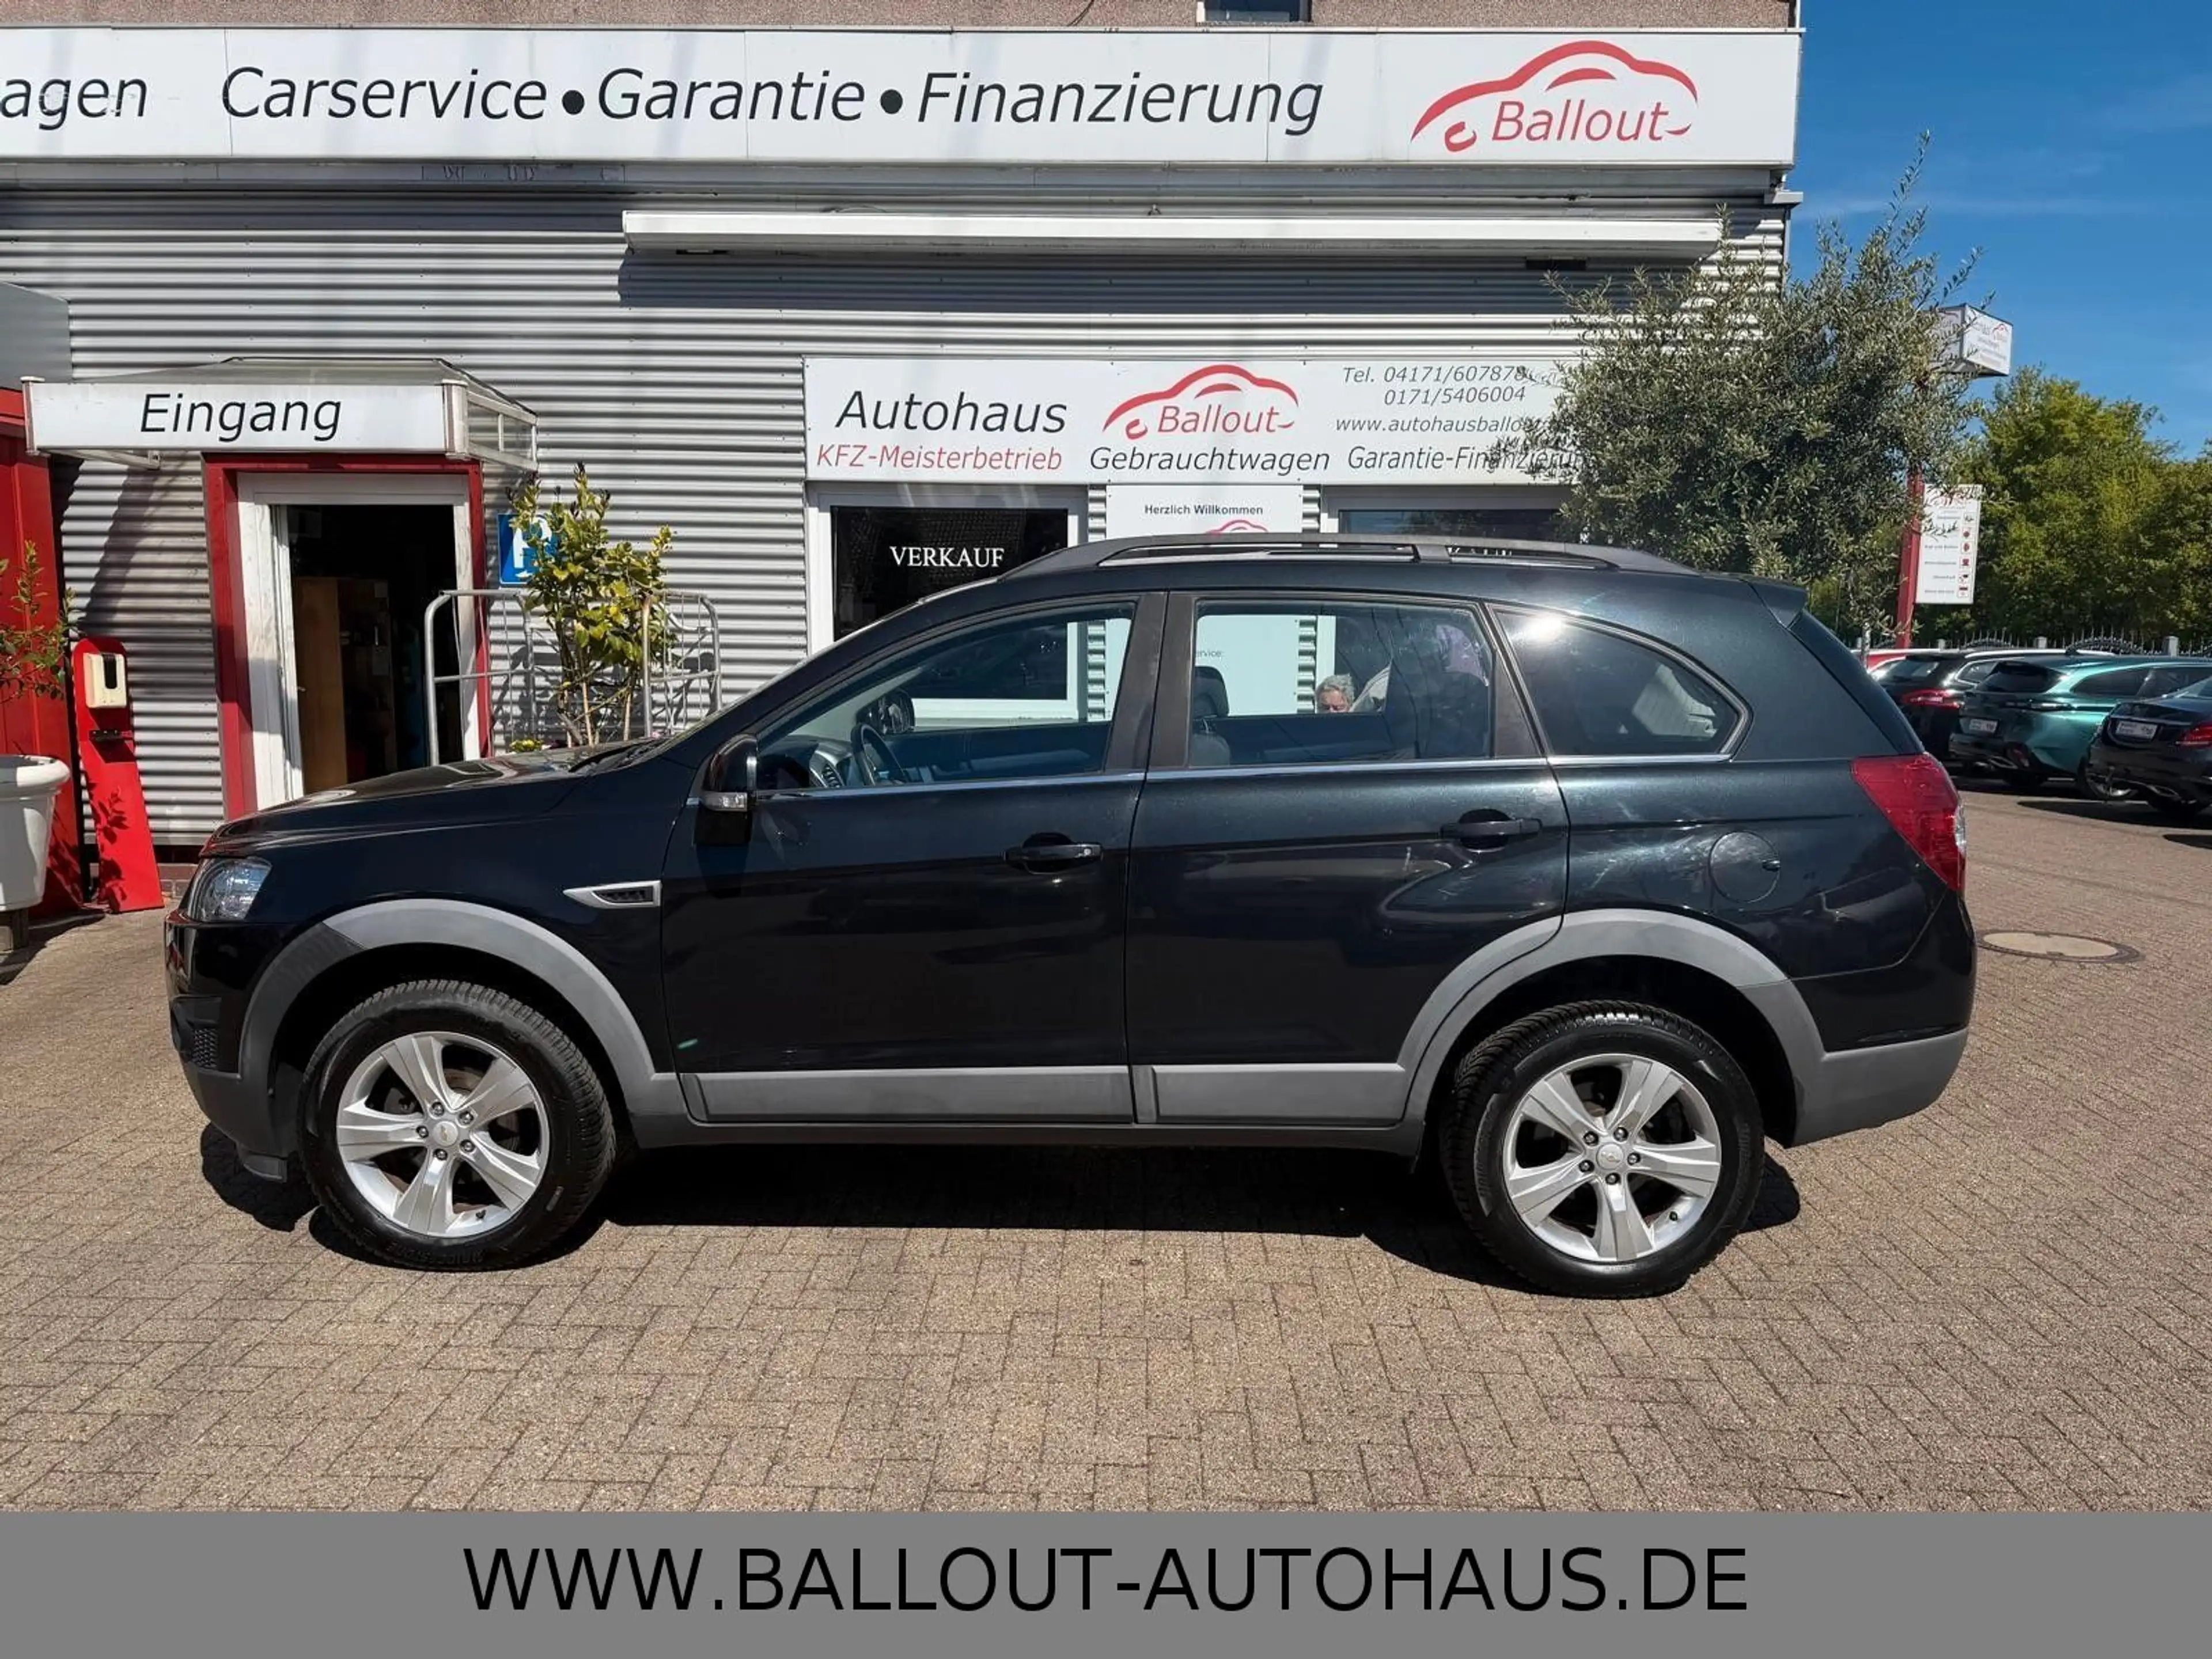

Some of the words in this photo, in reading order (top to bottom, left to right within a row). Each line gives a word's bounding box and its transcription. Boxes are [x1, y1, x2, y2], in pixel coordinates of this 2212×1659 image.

[0, 79, 147, 130] agen
[221, 66, 547, 120] Carservice
[598, 67, 865, 121] Garantie
[918, 71, 1324, 136] Finanzierung
[1491, 99, 1669, 141] Ballout
[1343, 366, 1374, 383] Tel.
[1384, 385, 1526, 406] 0171/5406004
[140, 392, 342, 442] Eingang
[834, 390, 1067, 434] Autohaus
[1157, 404, 1279, 433] Ballout
[817, 444, 1062, 471] KFZ-Meisterbetrieb
[1090, 446, 1330, 477] Gebrauchtwagen
[1145, 504, 1190, 516] Herzlich
[1194, 504, 1263, 516] Willkommen
[889, 546, 1005, 569] VERKAUF
